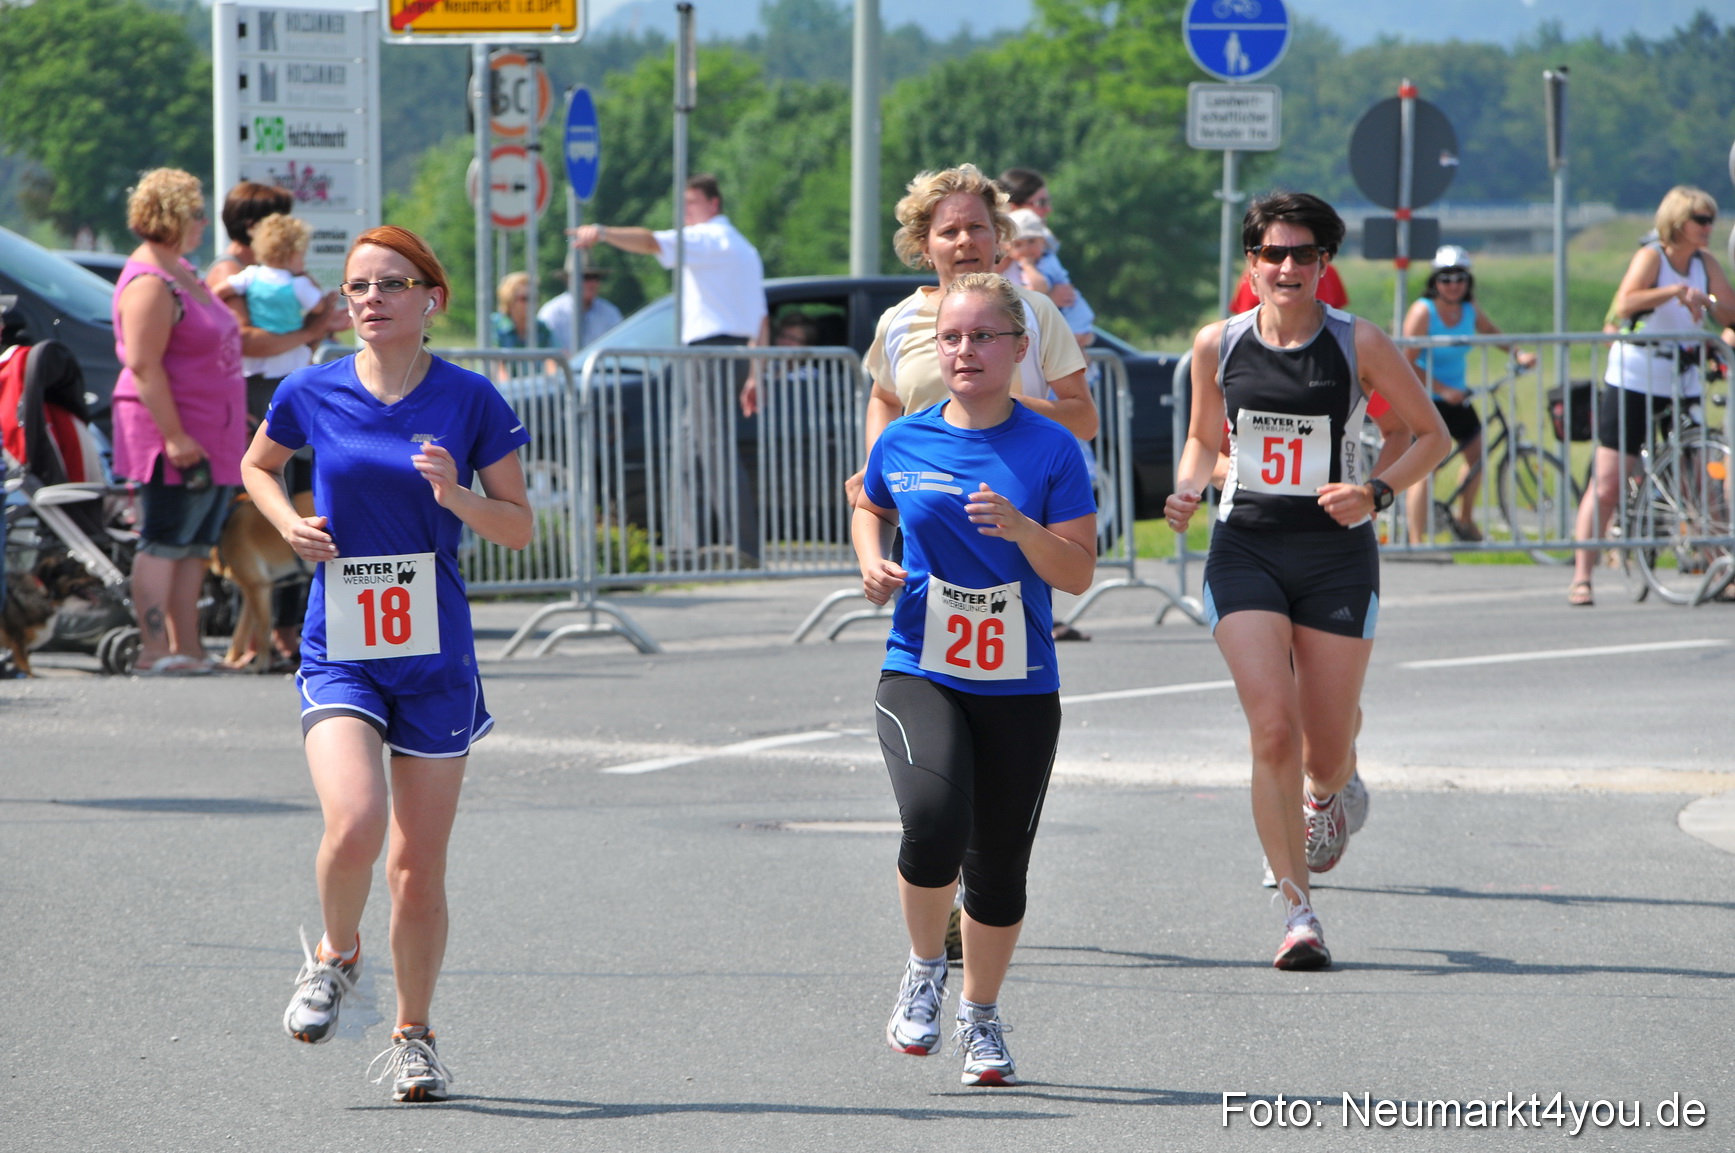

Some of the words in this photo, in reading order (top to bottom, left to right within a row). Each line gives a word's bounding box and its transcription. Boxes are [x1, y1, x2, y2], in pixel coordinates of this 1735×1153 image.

[1252, 415, 1295, 427] MEYER
[1252, 423, 1296, 434] WERBUNG
[1261, 436, 1303, 486] 51
[343, 562, 393, 576] MEYER
[342, 574, 395, 585] WERBUNG
[942, 586, 986, 605] MEYER
[942, 598, 989, 613] WERBUNG
[357, 586, 412, 647] 18
[945, 613, 1005, 671] 26
